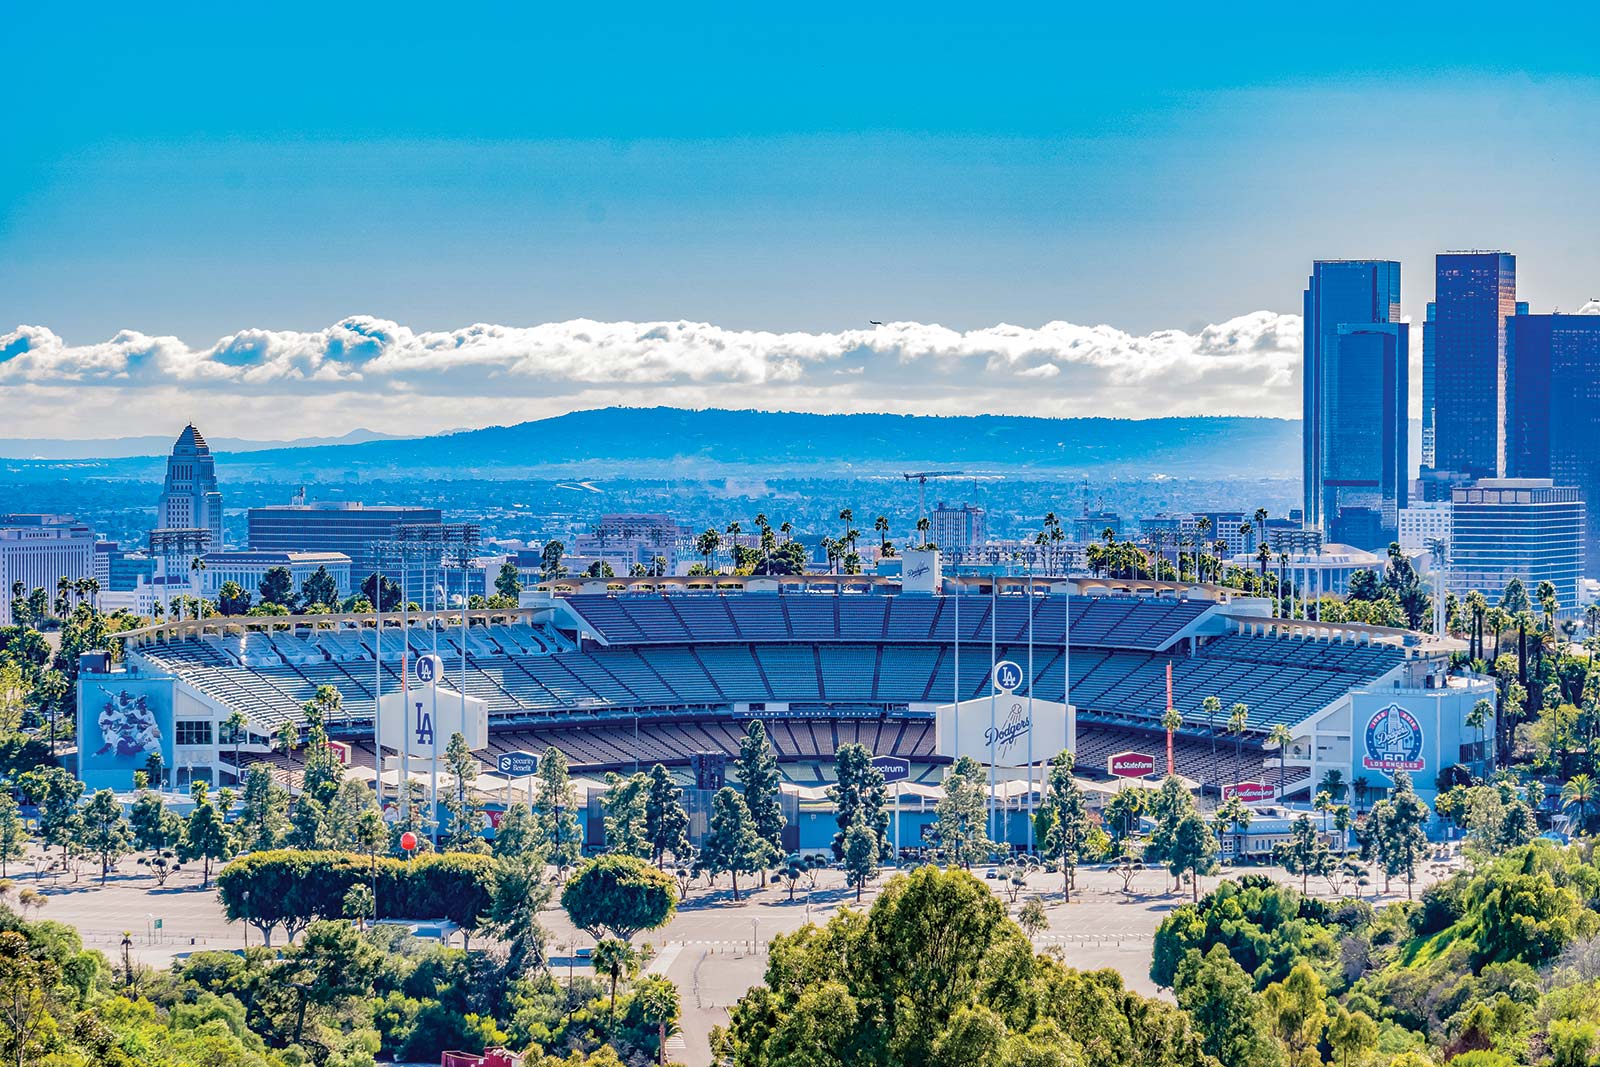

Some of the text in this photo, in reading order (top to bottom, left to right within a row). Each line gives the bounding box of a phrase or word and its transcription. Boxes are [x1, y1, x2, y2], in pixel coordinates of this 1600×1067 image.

[421, 660, 431, 679] LA
[1003, 667, 1015, 686] LA
[416, 703, 433, 744] LA
[985, 717, 1032, 746] Dodgers
[1376, 726, 1410, 746] Dodgers
[512, 757, 534, 765] Security
